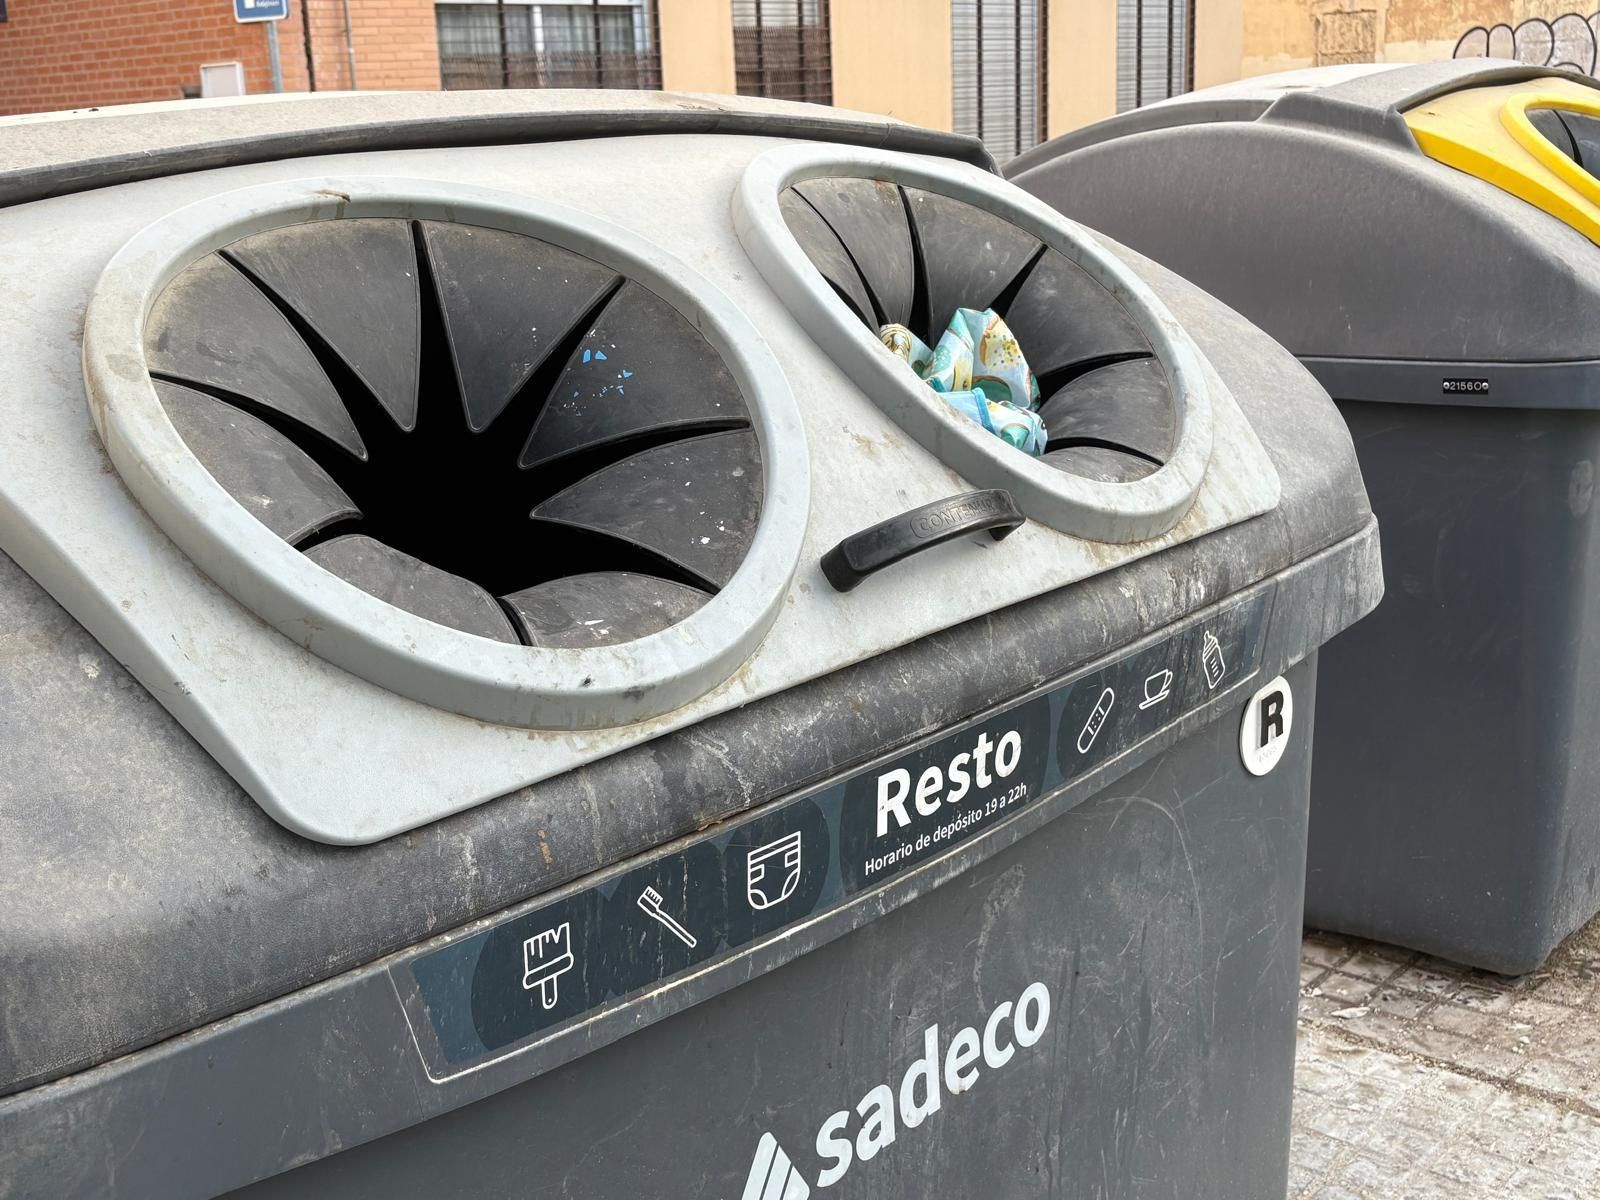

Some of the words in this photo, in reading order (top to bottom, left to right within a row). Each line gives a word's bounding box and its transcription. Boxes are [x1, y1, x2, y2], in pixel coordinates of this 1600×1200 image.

[1449, 381, 1482, 391] 21560
[919, 497, 995, 531] CONTENUR
[1260, 690, 1284, 748] R
[876, 730, 1022, 838] Resto
[865, 843, 913, 876] Horario
[915, 834, 931, 851] de
[933, 811, 983, 843] depósito
[984, 798, 998, 816] 19
[999, 796, 1006, 809] a
[1007, 782, 1027, 805] 22h
[815, 981, 1051, 1188] sadeco
